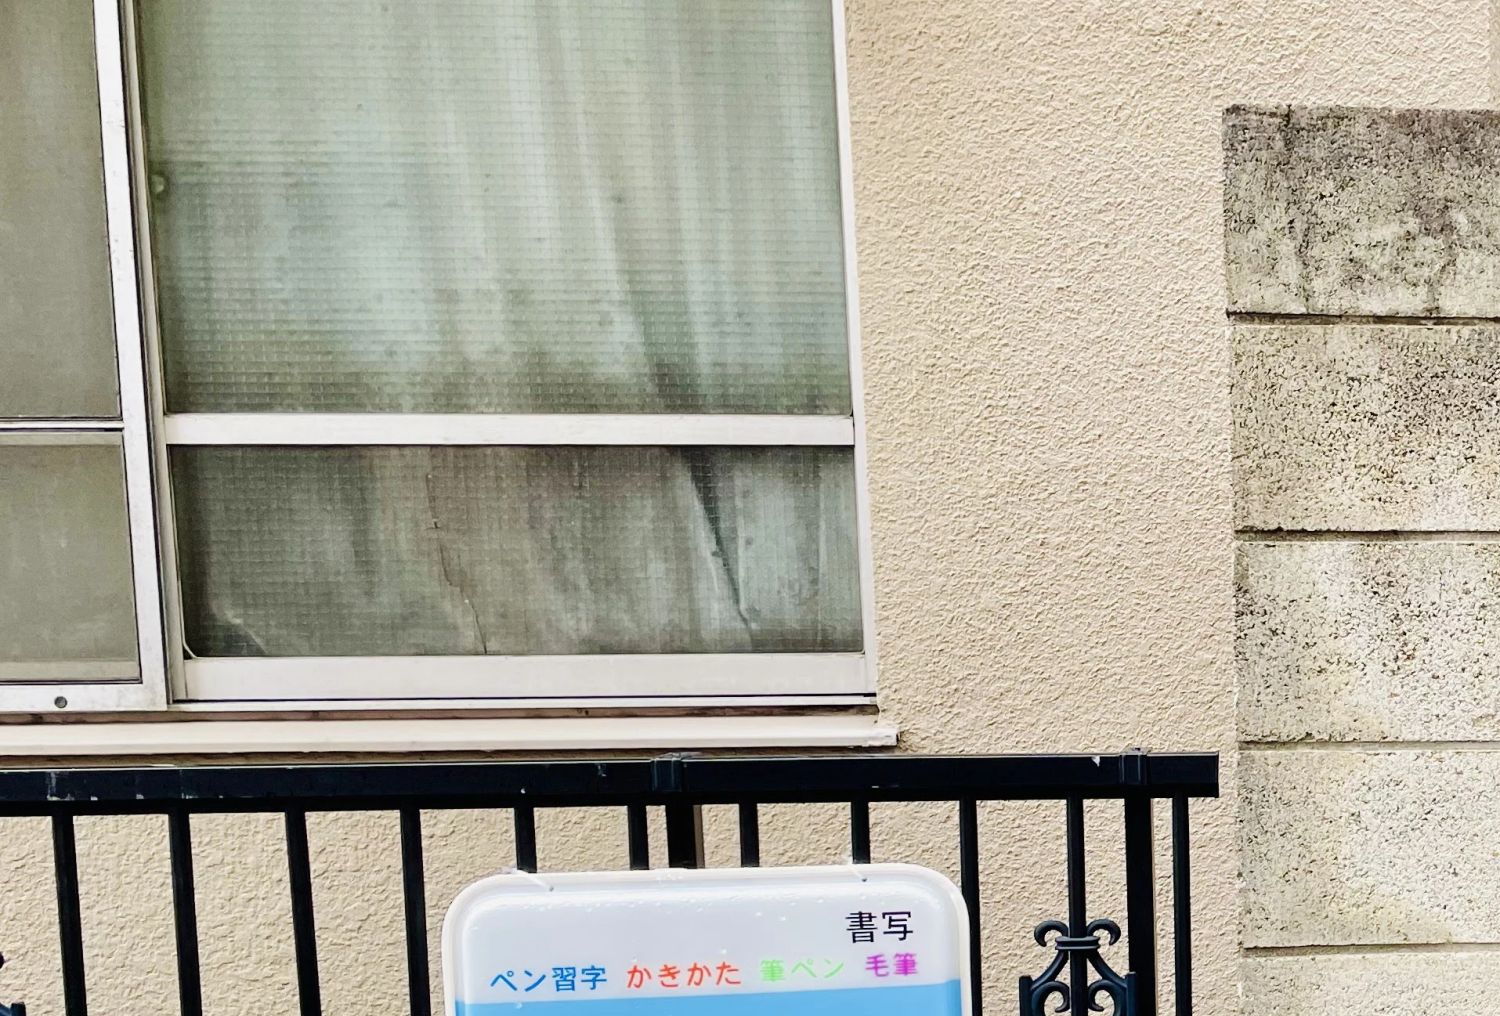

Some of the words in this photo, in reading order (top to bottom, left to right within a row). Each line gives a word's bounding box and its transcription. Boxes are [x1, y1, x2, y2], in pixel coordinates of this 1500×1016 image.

[845, 911, 914, 943] 書写
[490, 964, 608, 992] ペン習字
[626, 960, 741, 988] かきかた
[759, 957, 845, 983] 筆ペン
[865, 952, 918, 978] 毛筆
